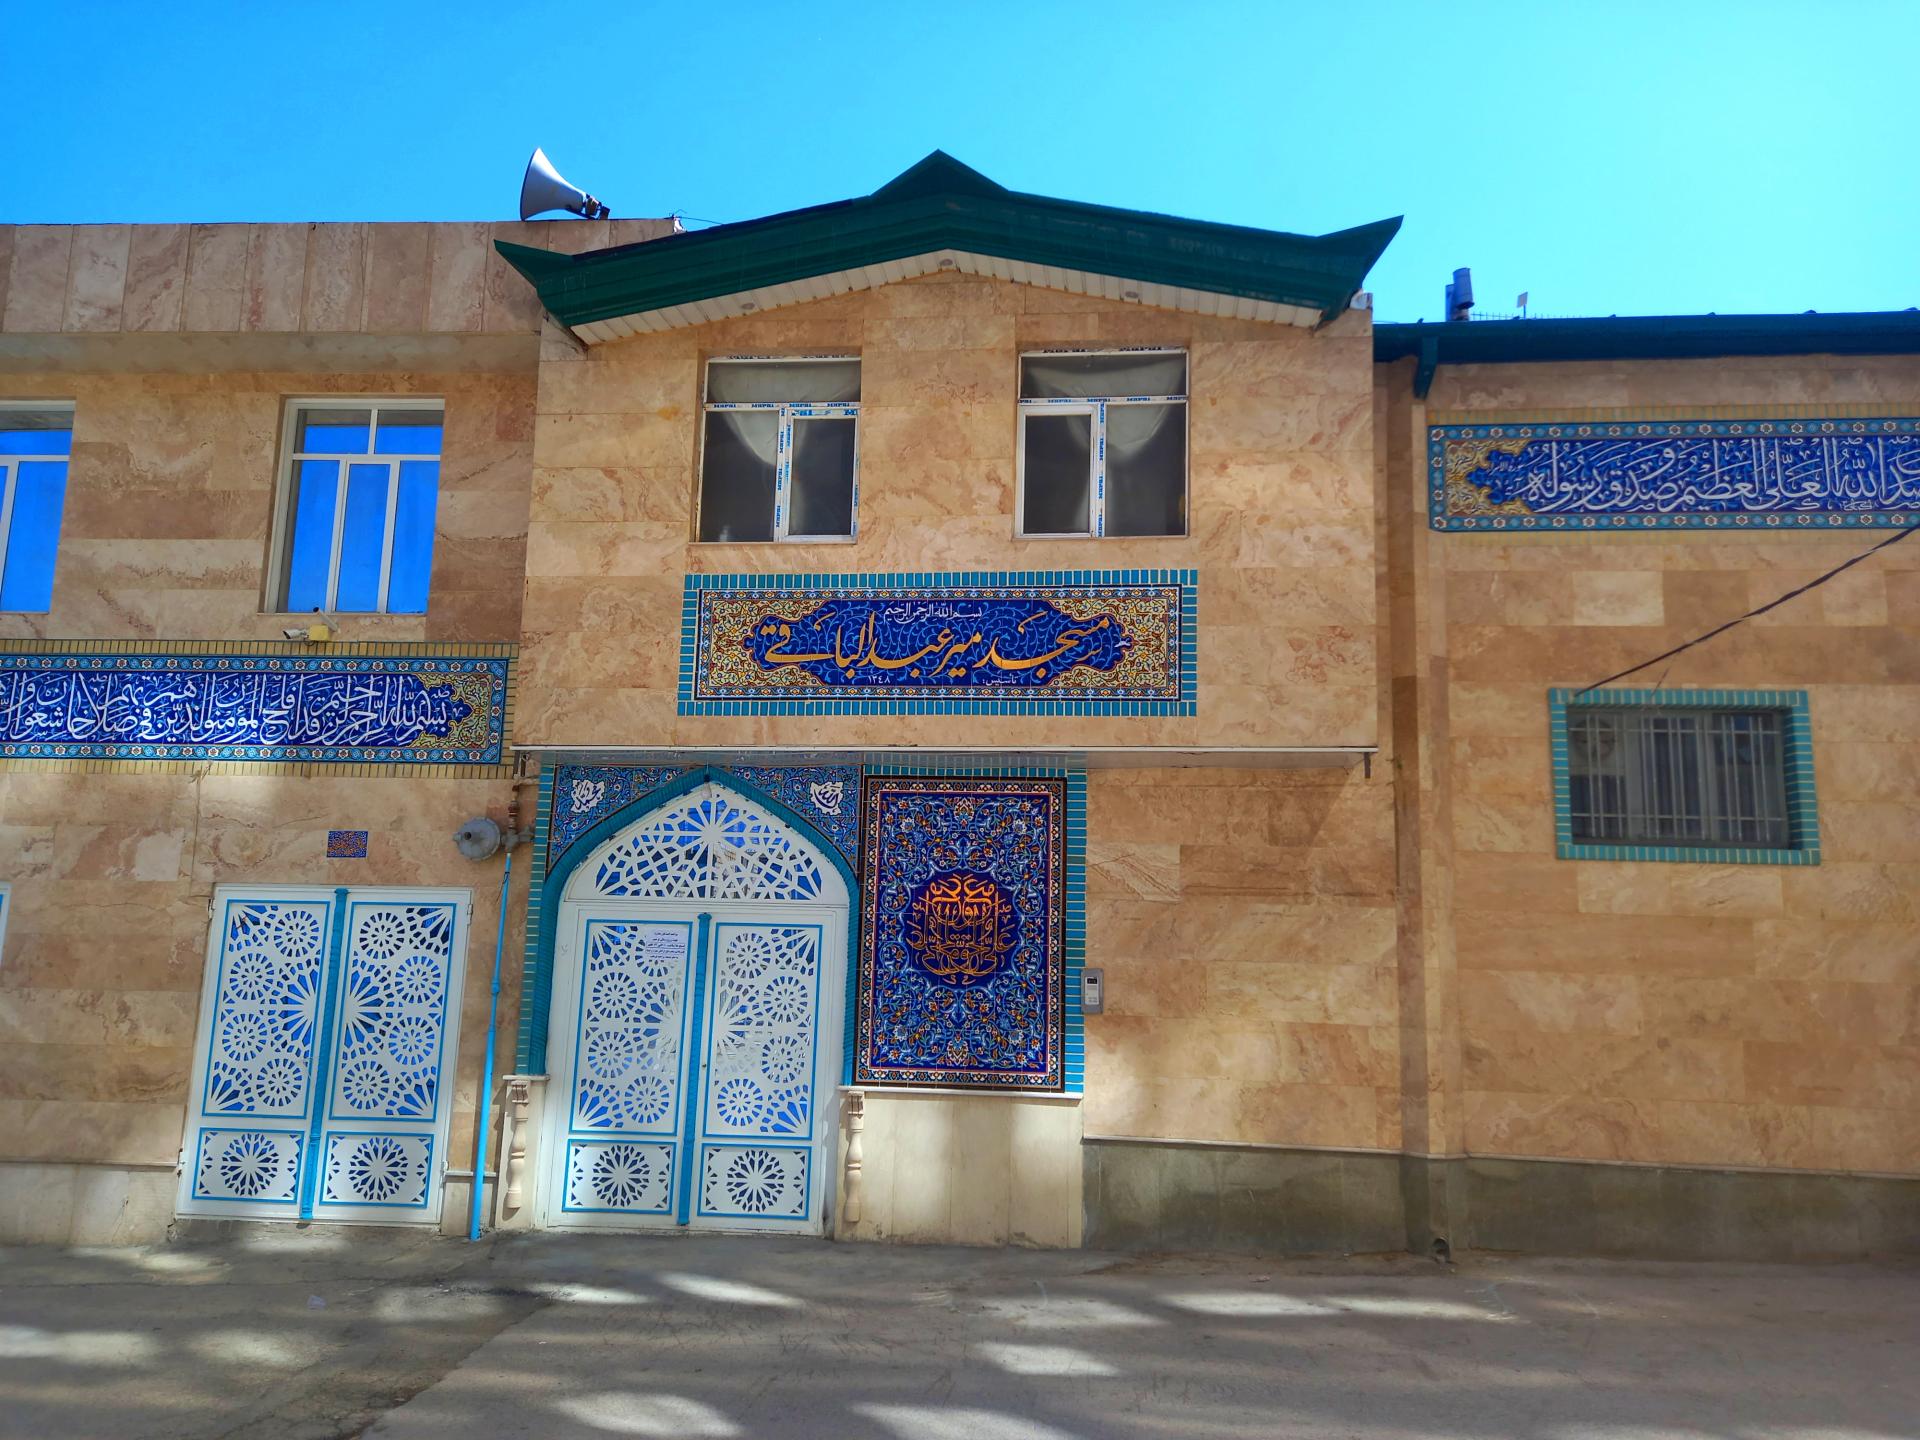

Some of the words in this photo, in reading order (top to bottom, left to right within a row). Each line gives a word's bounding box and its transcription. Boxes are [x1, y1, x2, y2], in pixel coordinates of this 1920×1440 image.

[894, 602, 934, 624] الرحمن
[935, 602, 952, 618] الله
[946, 604, 983, 621] بسم
[931, 631, 983, 678] میر
[972, 612, 1111, 680] مسجد
[396, 690, 448, 747] بسم
